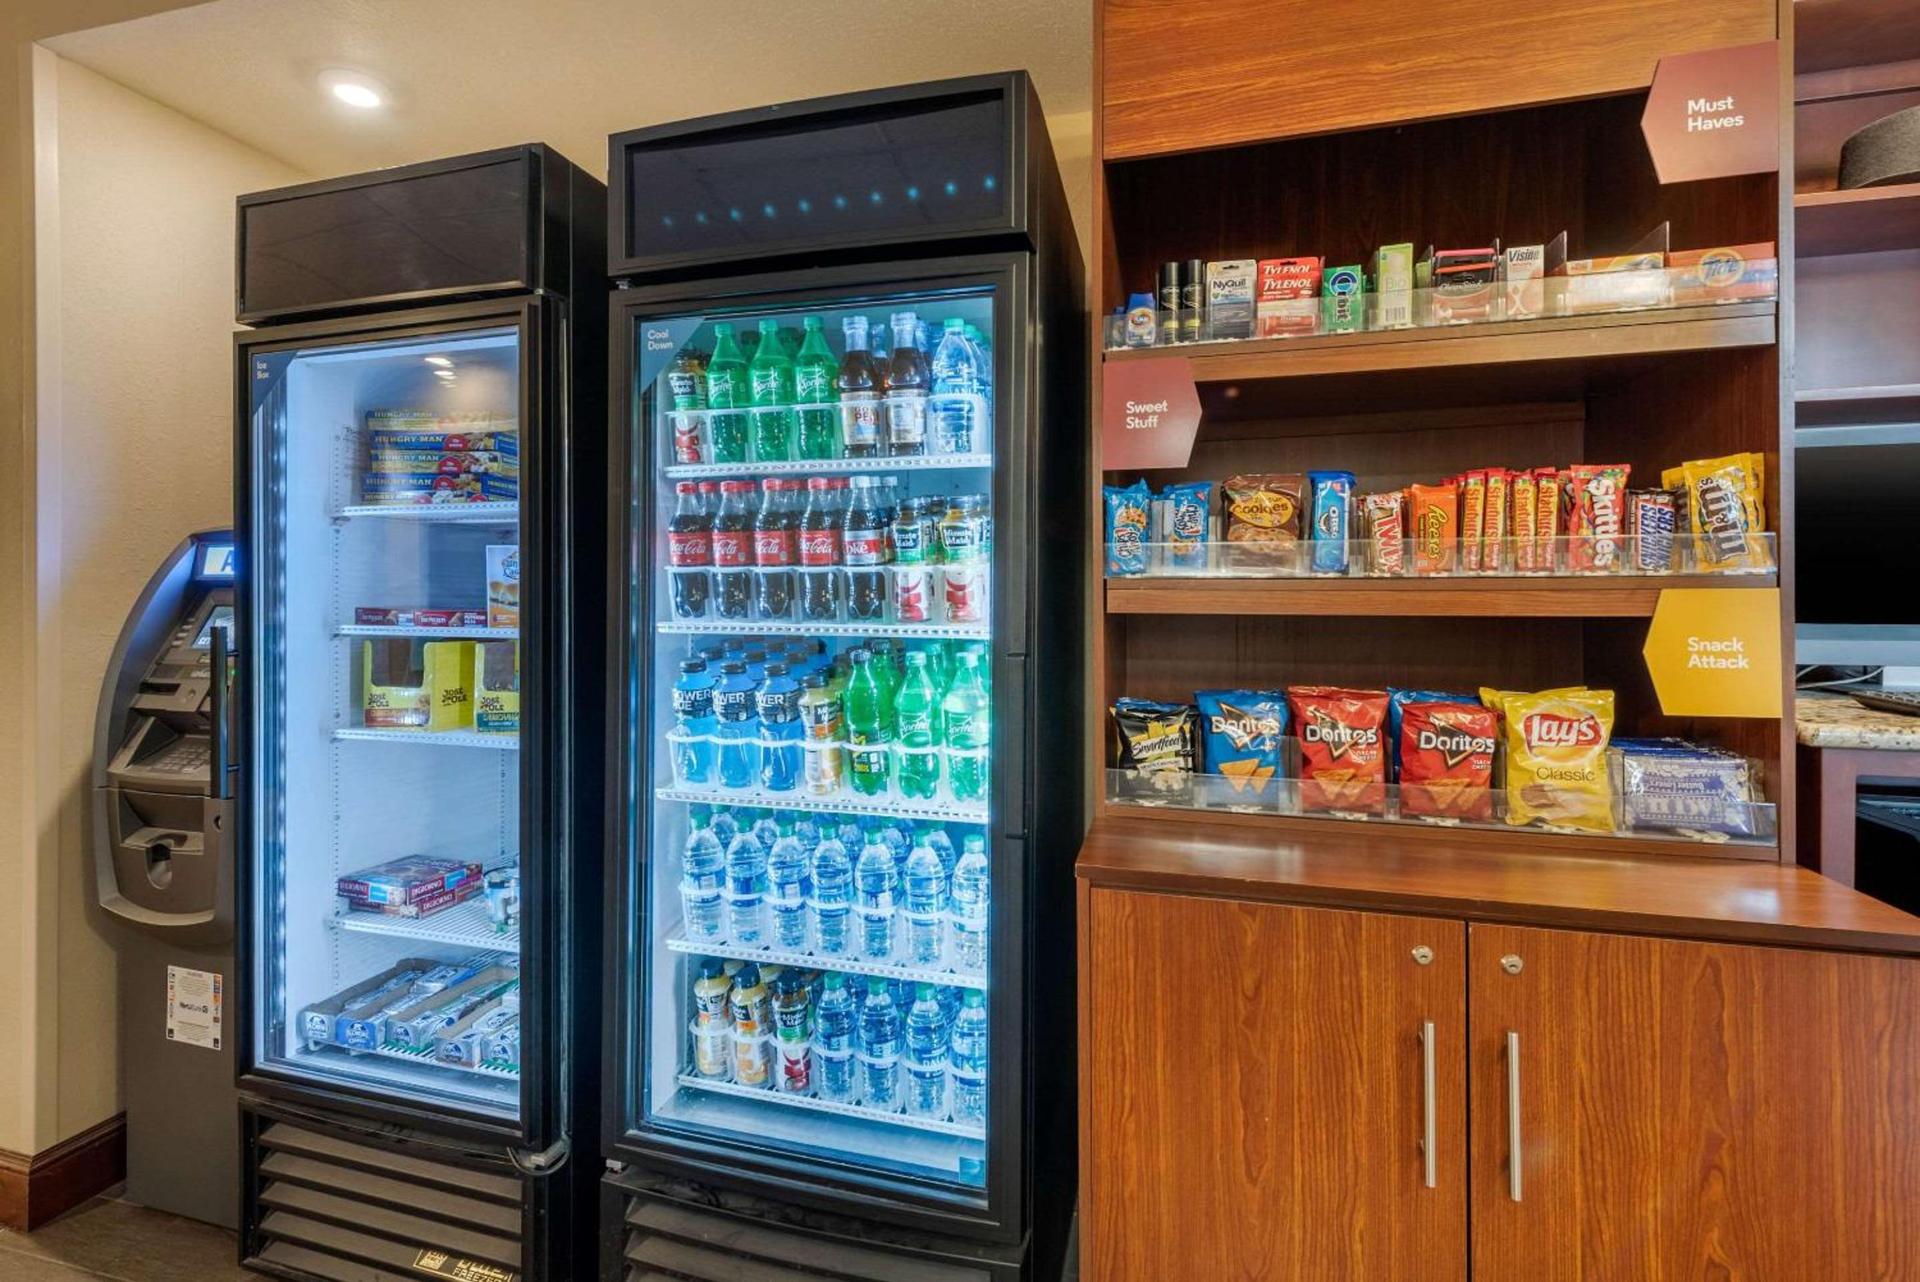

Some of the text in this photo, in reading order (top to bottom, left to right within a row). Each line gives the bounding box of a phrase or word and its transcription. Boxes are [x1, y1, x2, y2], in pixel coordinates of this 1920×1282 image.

[1688, 97, 1734, 114] Must
[1688, 115, 1744, 132] Haves
[1213, 280, 1246, 290] NyQuil
[1264, 279, 1312, 290] TYLENOL
[648, 329, 669, 339] Cool
[648, 341, 673, 350] Down
[1126, 400, 1168, 413] Sweet
[1126, 416, 1158, 429] Stuff
[1329, 506, 1339, 538] OREO
[1588, 478, 1618, 566] Skittles
[1641, 504, 1656, 568] SNICKERS
[1688, 637, 1744, 652] Snack
[1688, 655, 1749, 669] Attack
[1306, 724, 1378, 744] Doritos
[1531, 715, 1596, 747] Lay's
[1419, 730, 1495, 753] Doritos
[1536, 767, 1596, 782] Classic
